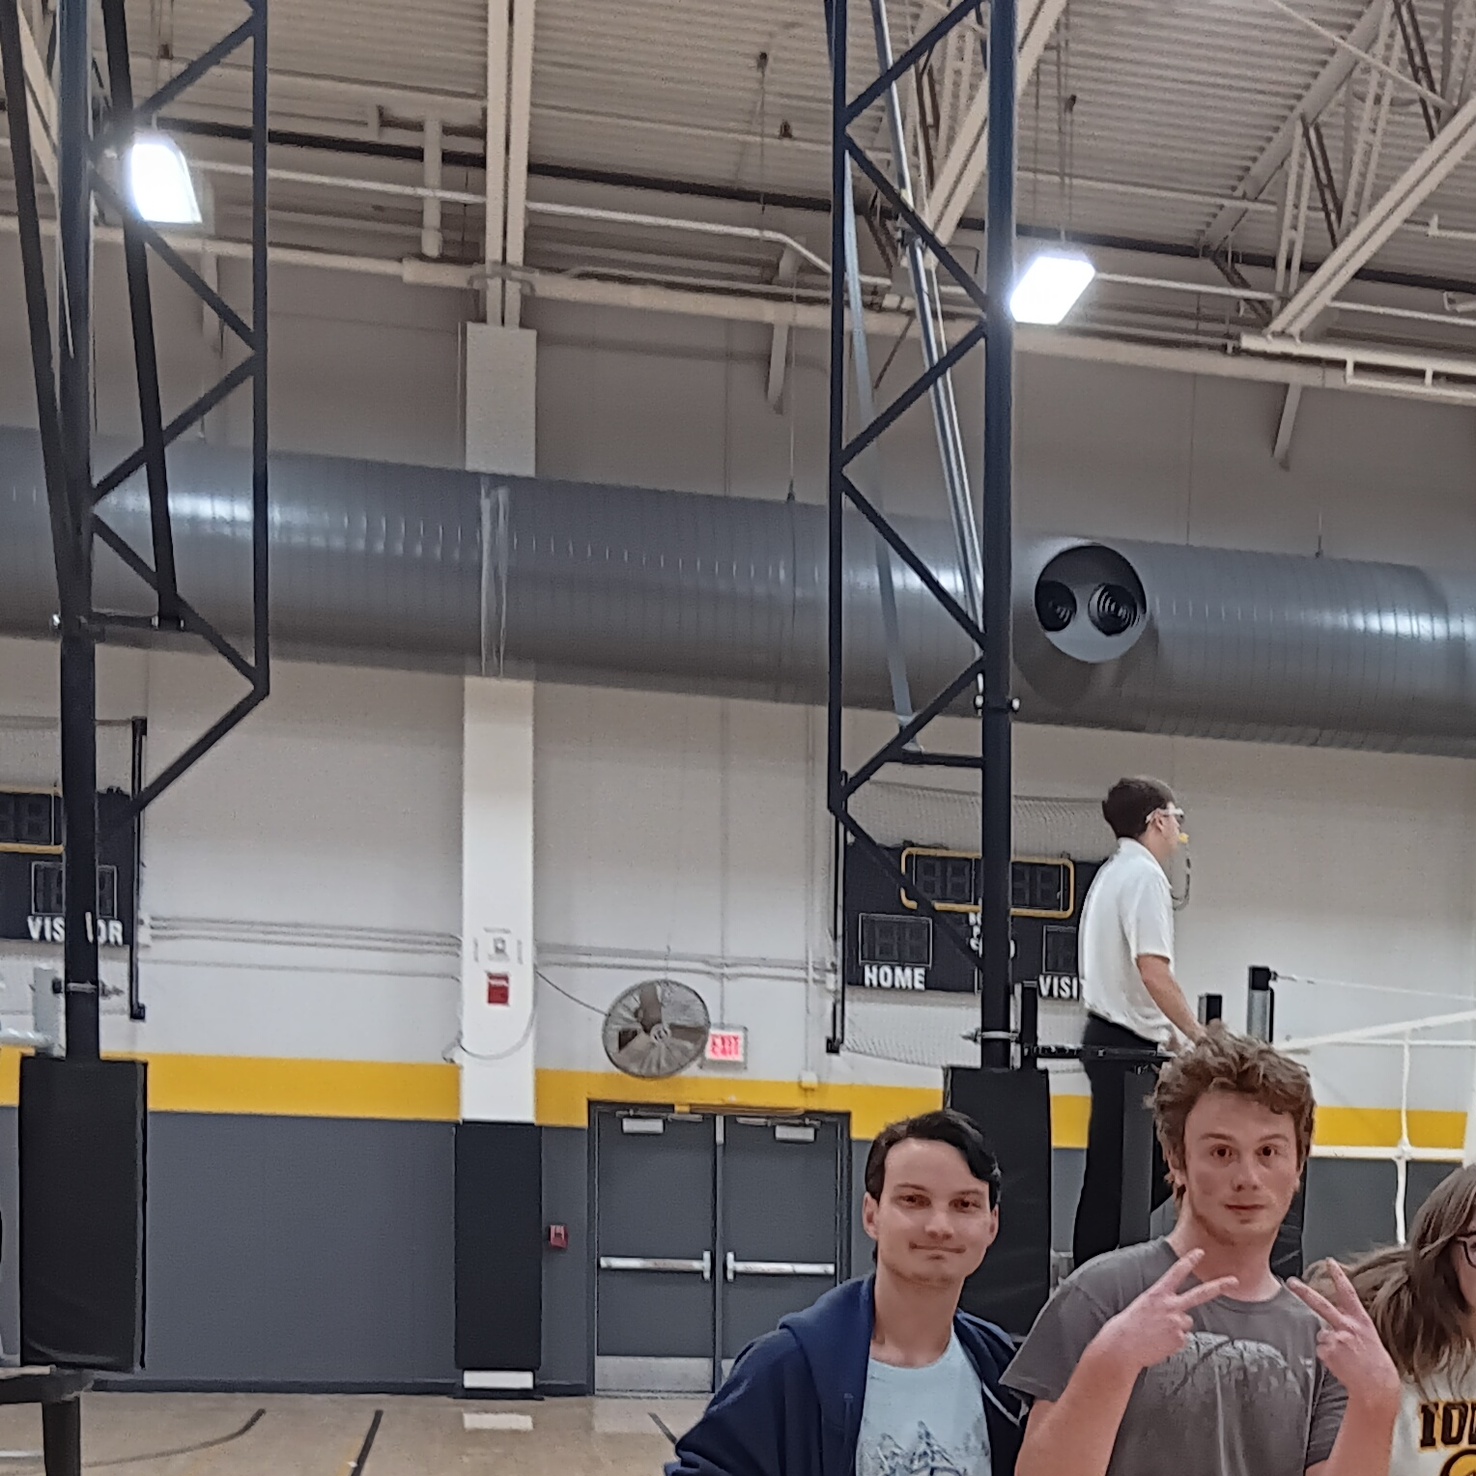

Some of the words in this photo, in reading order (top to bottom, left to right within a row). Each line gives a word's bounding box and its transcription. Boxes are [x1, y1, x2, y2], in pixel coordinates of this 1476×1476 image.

[27, 914, 123, 946] VISOR
[864, 964, 926, 991] HOME
[1039, 975, 1077, 1000] VISI
[710, 1034, 740, 1057] EXIT
